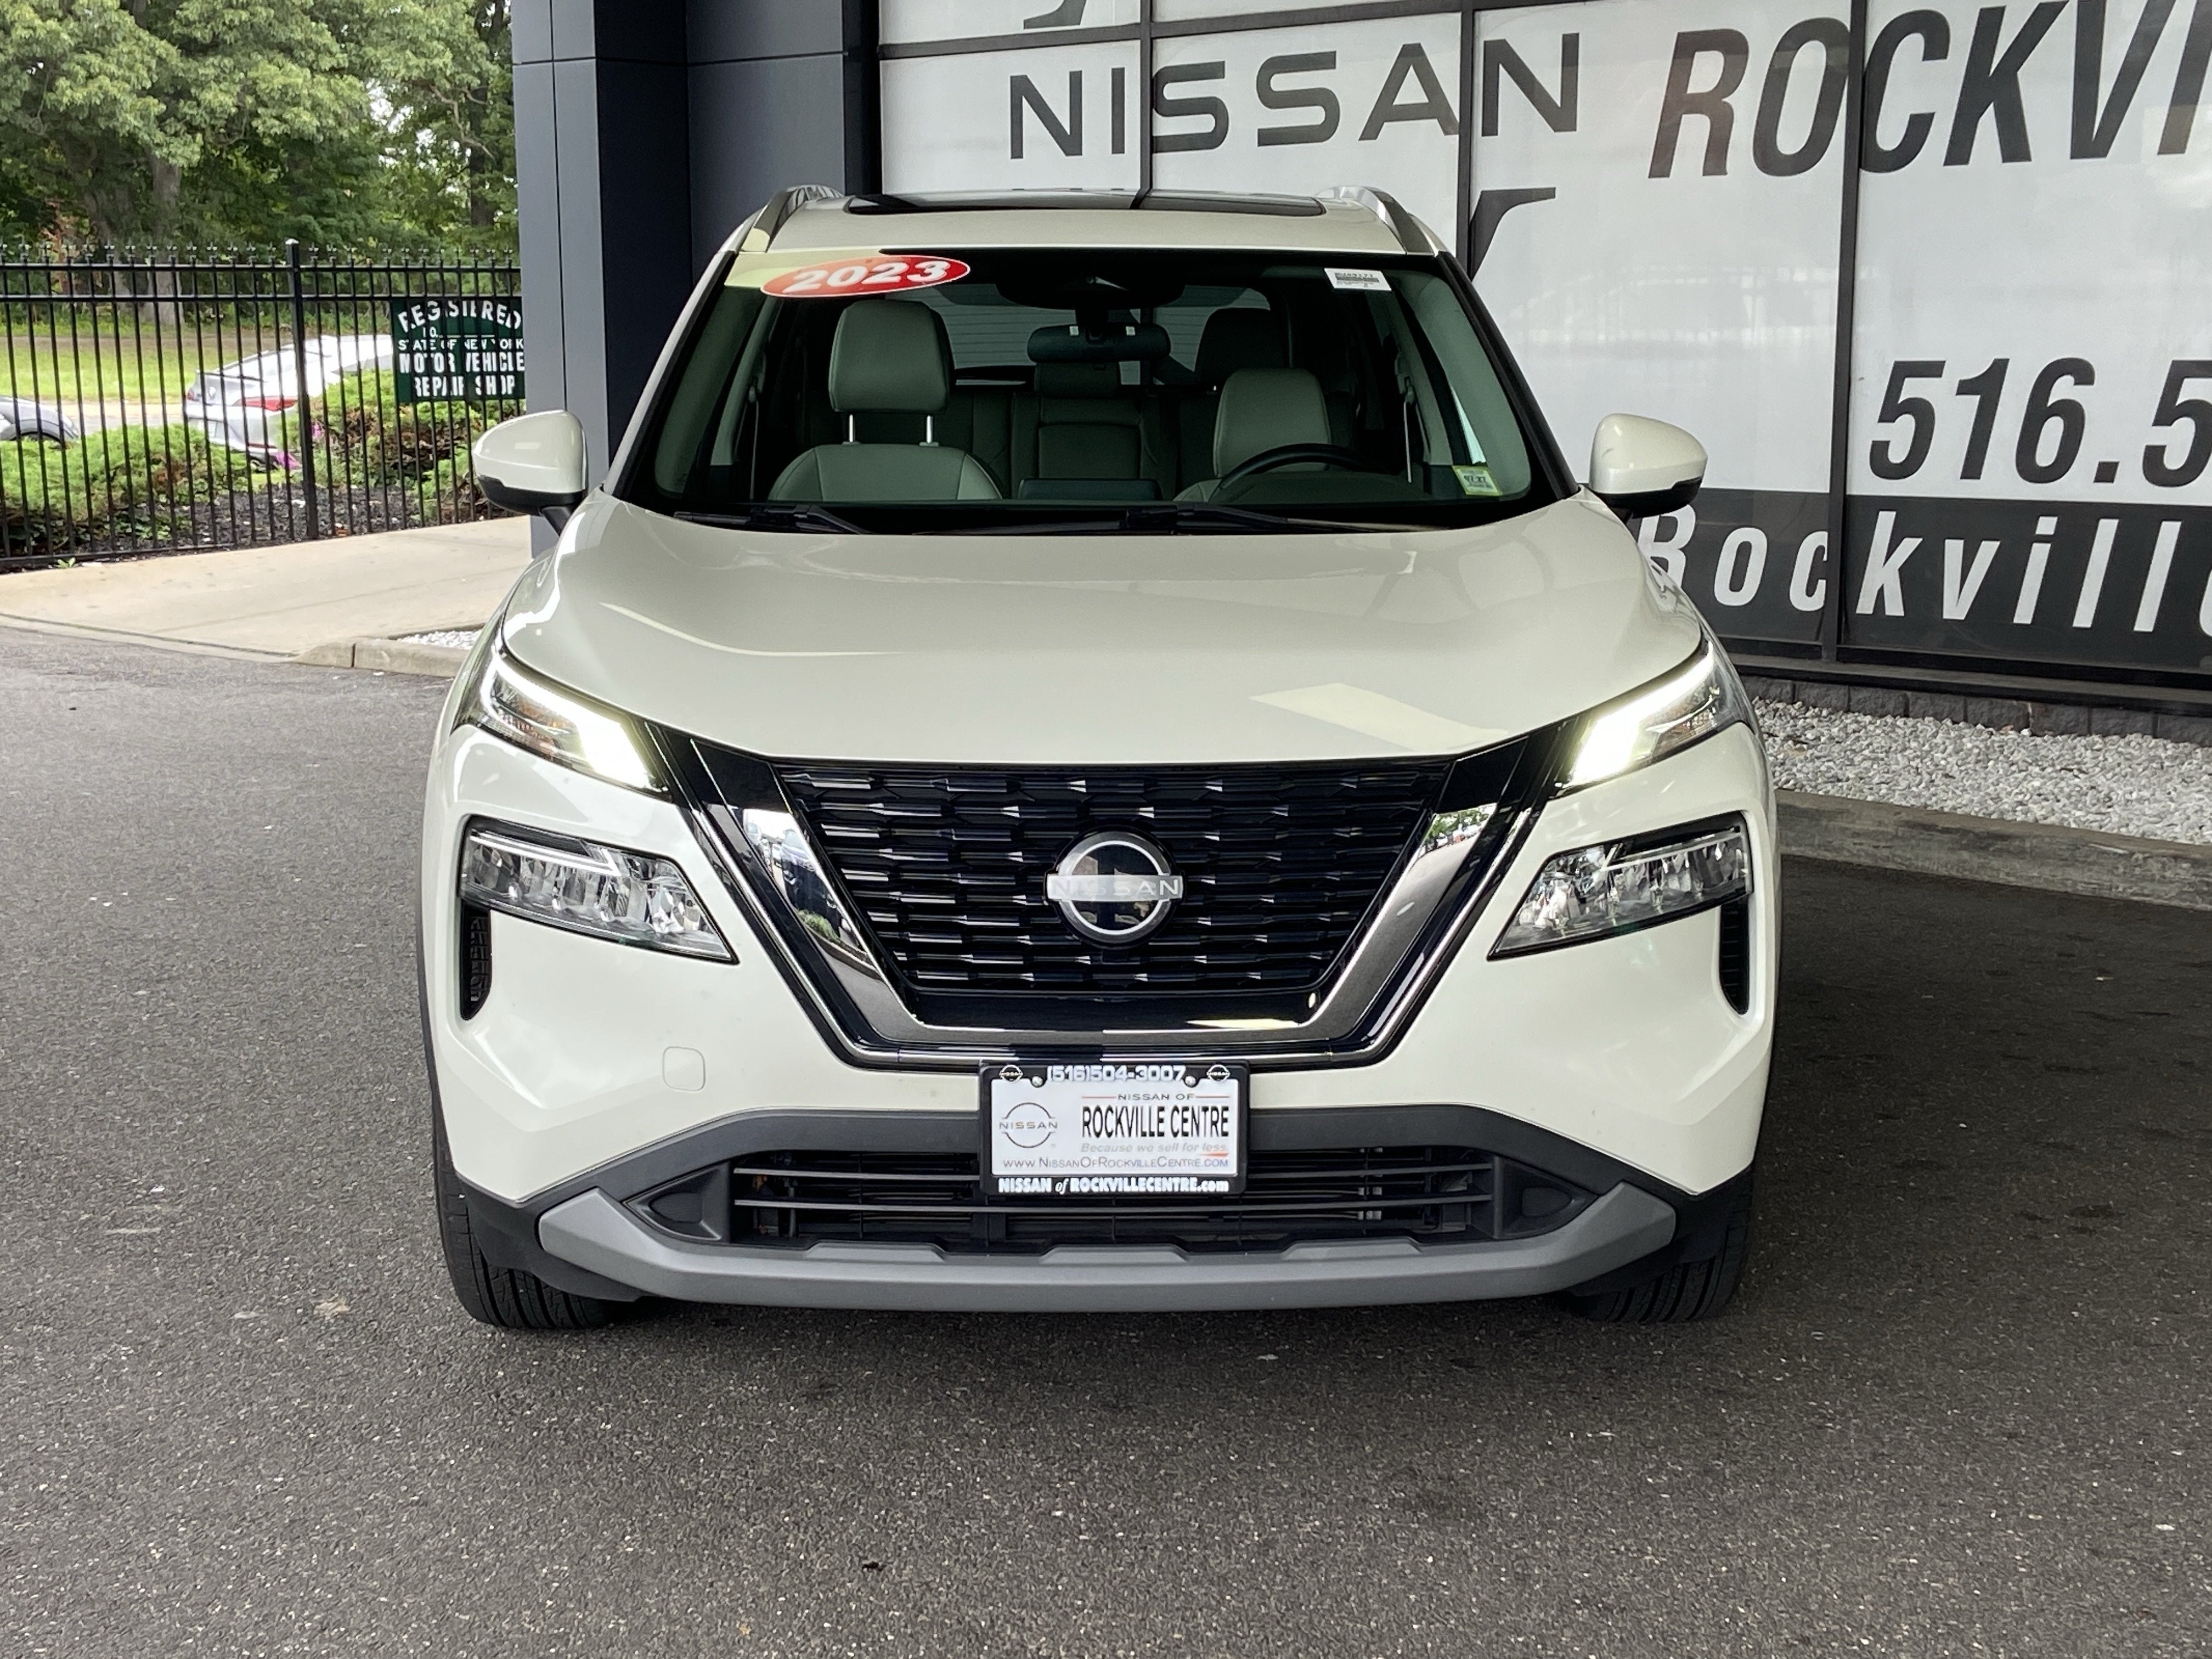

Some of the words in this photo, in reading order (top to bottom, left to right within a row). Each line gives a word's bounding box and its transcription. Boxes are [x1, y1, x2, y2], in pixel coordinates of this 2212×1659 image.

[1010, 33, 1579, 159] NISSAN
[1648, 0, 2212, 178] ROCKVI
[783, 261, 951, 293] 2023
[398, 339, 437, 351] SATE
[399, 353, 455, 373] MOOR
[1869, 357, 2212, 488] 516.5
[1638, 504, 2212, 637] Rockvill
[1047, 1065, 1186, 1081] (516)504-3007
[998, 1121, 1058, 1130] NISSAN
[1082, 1105, 1165, 1138] ROCKVILLE
[1170, 1105, 1229, 1138] CENTRE
[1081, 1143, 1133, 1153] Because
[1158, 1142, 1179, 1152] sell
[1182, 1142, 1201, 1152] for
[998, 1176, 1052, 1193] NISSAN
[1055, 1178, 1069, 1195] of
[1070, 1176, 1229, 1193] ROCKVILLECENTRE.com
